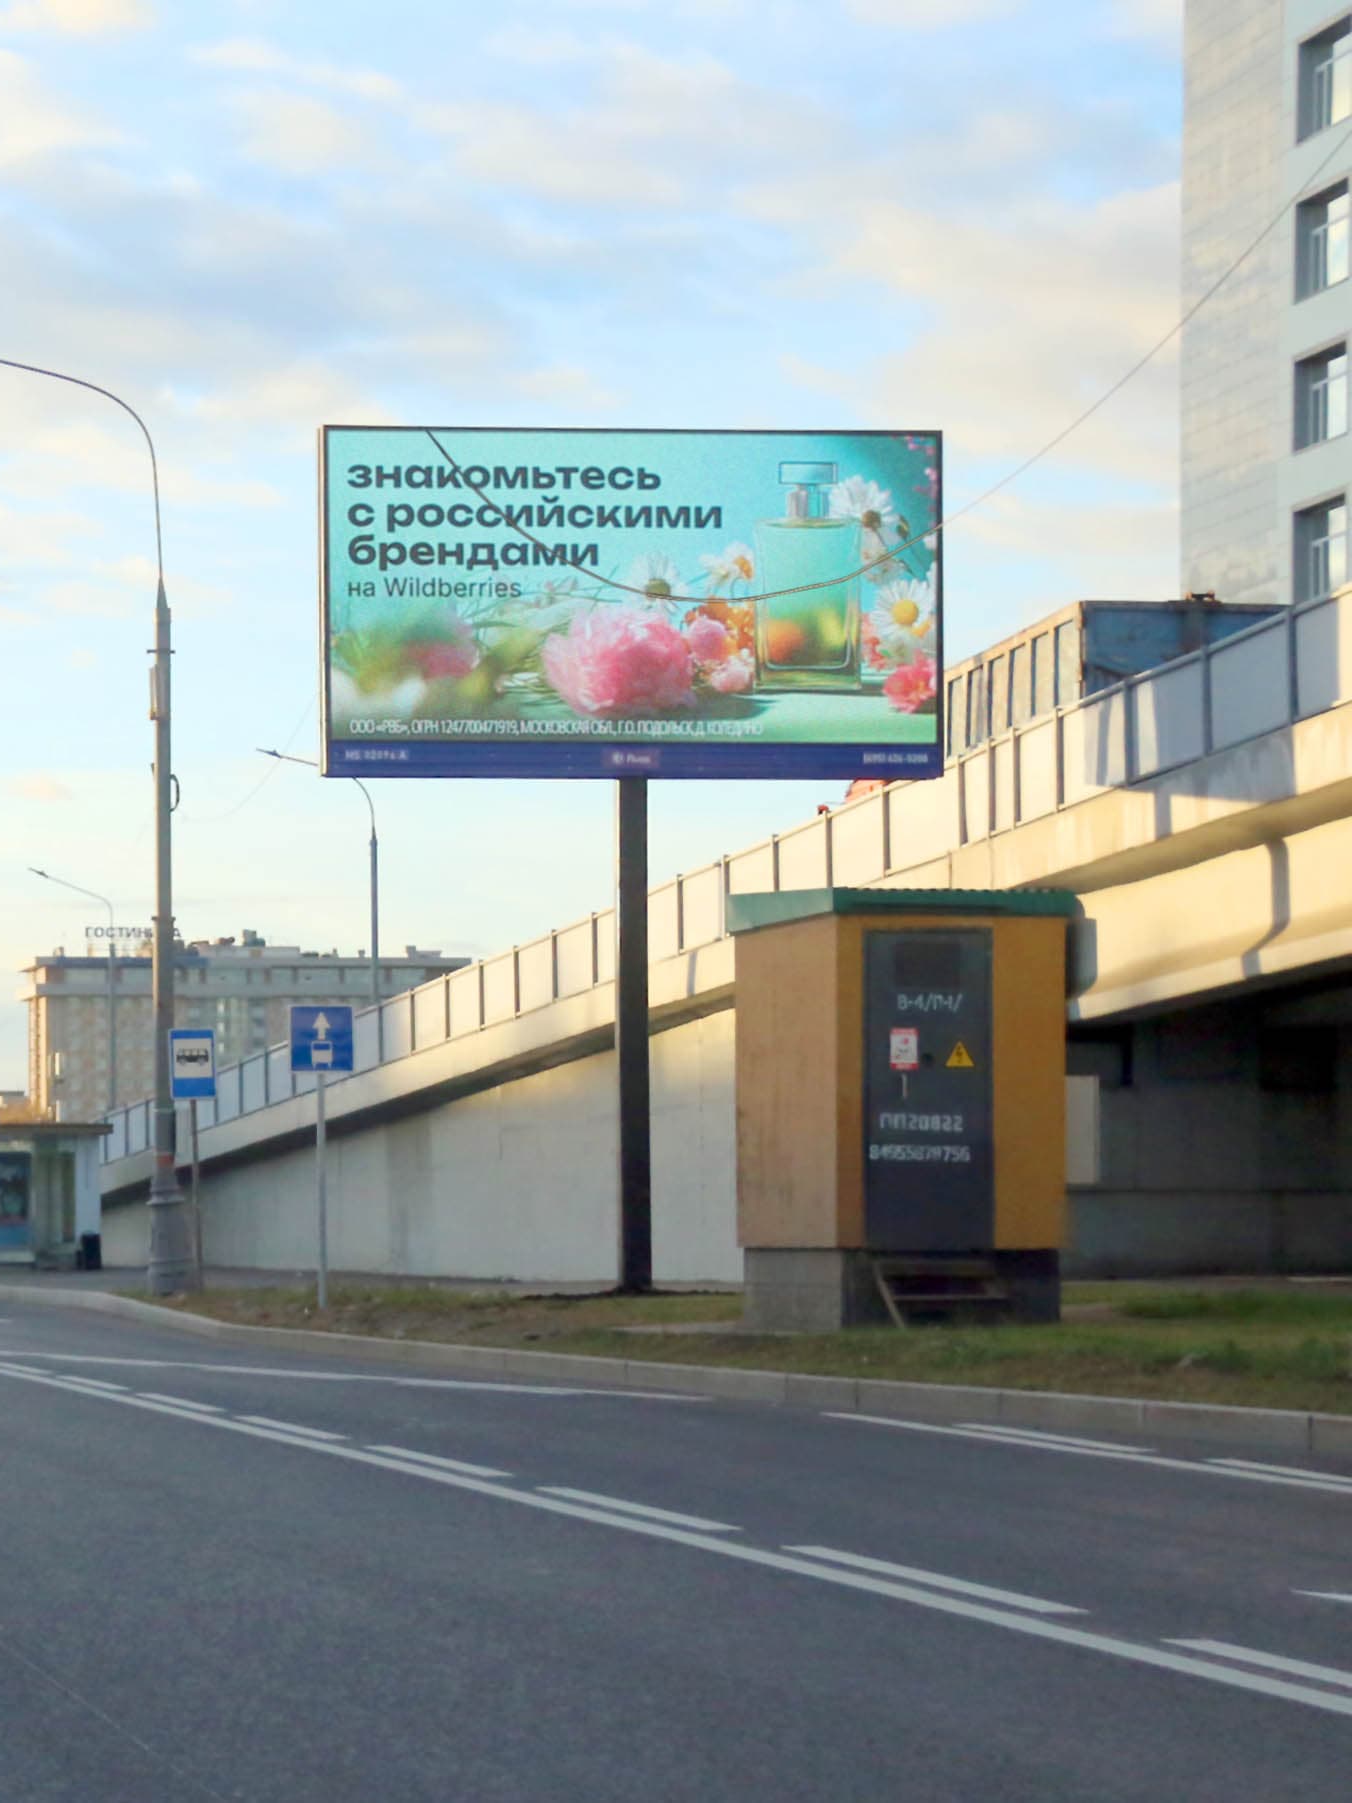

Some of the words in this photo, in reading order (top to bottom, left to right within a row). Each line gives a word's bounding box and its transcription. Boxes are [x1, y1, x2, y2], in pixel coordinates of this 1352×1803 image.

[347, 462, 662, 490] знакомьтесь
[347, 502, 374, 528] с
[387, 496, 723, 533] российскими
[348, 536, 599, 570] брендами
[348, 580, 377, 598] на
[384, 576, 522, 599] Wildberries
[85, 927, 181, 938] ГОСТИНИА
